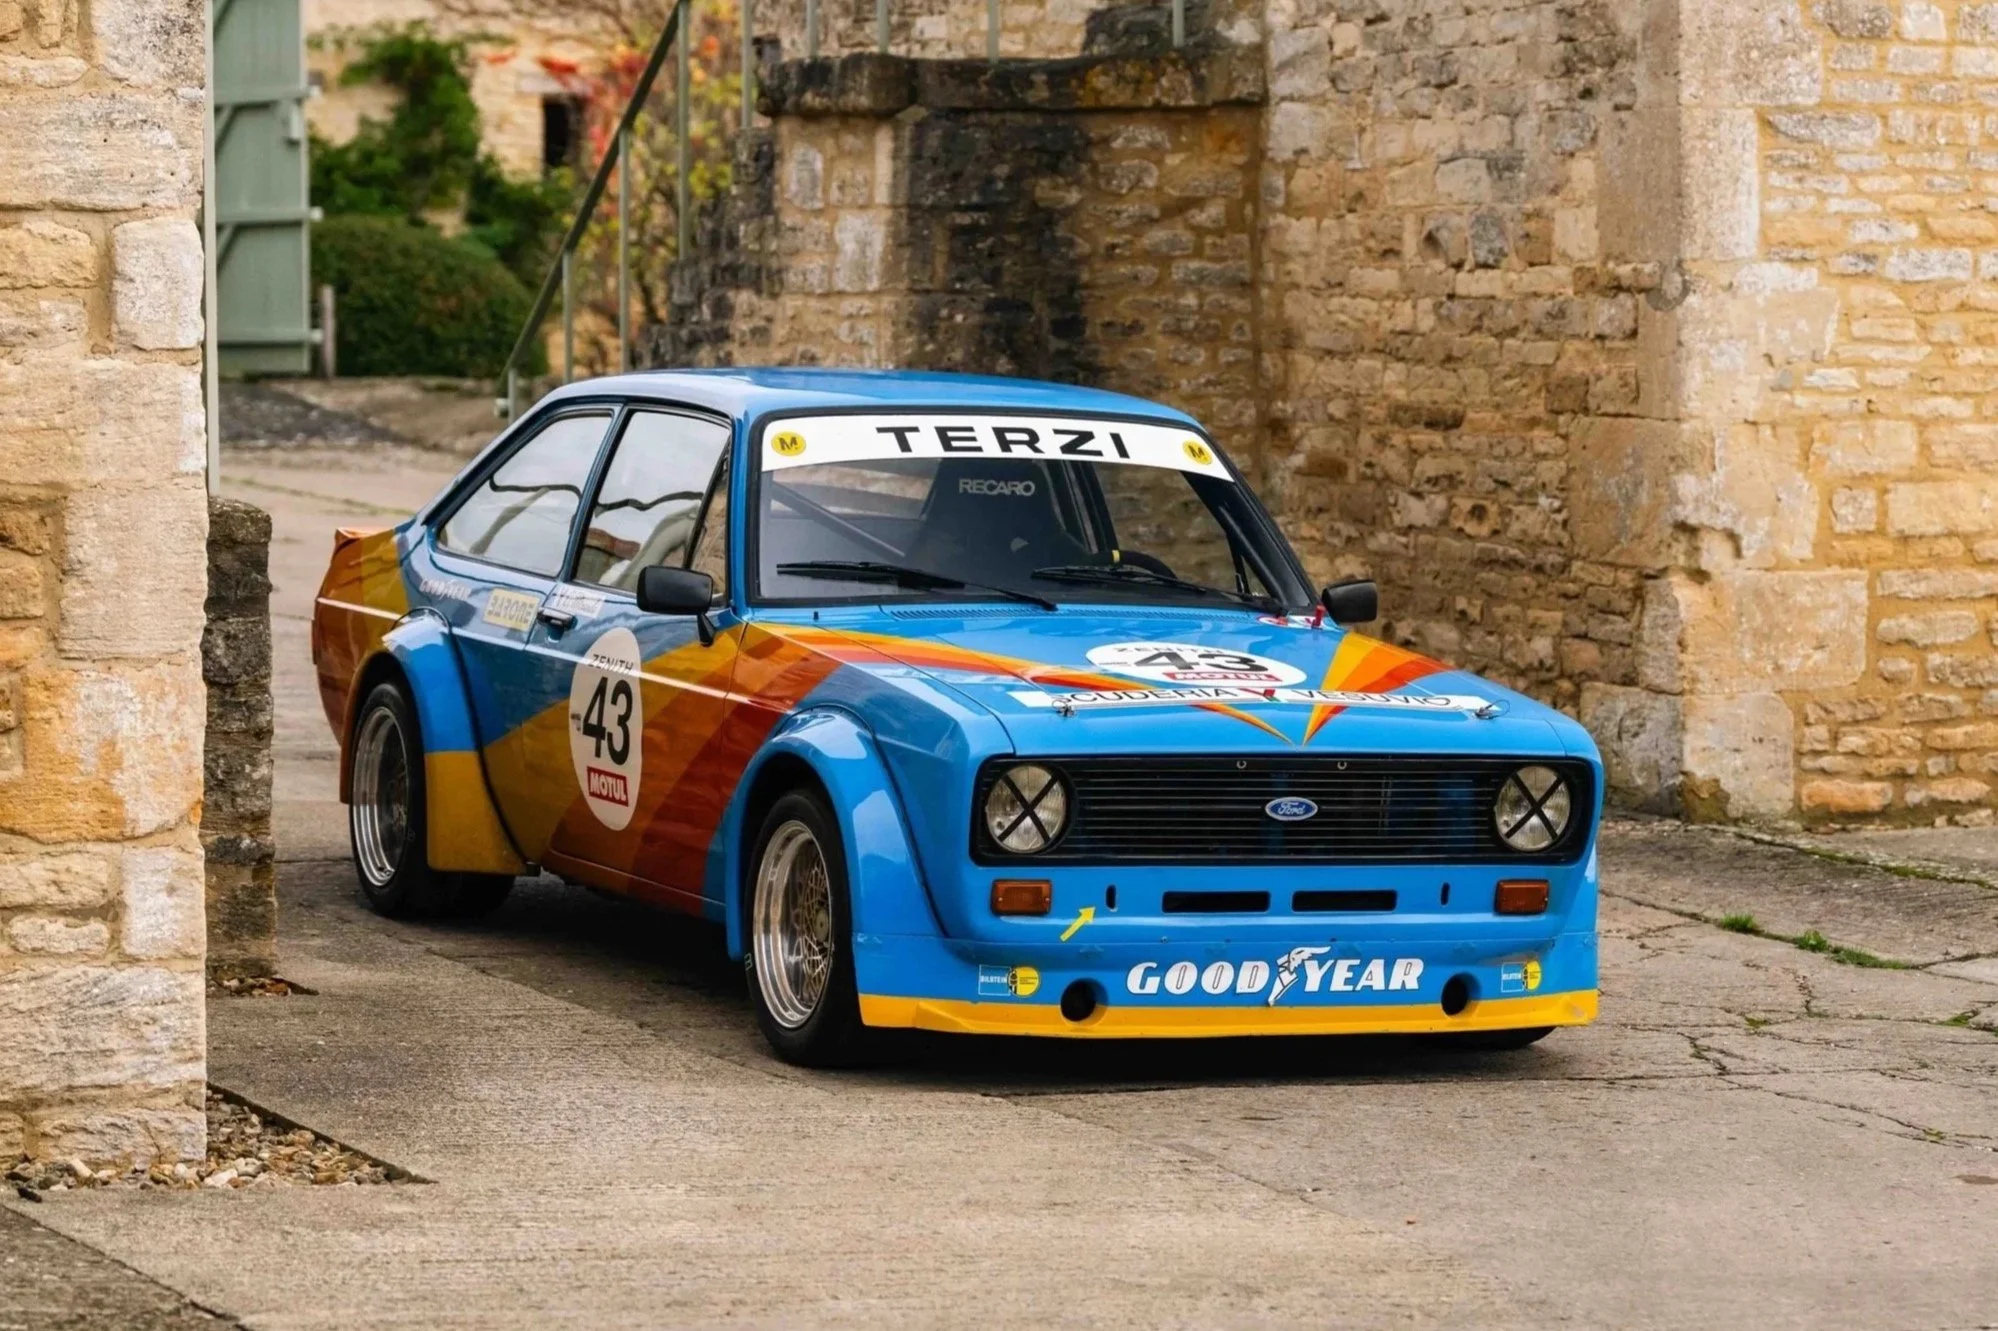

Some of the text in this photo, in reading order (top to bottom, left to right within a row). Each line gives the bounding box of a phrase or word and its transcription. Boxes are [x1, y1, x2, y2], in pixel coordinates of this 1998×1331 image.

[876, 426, 1130, 459] TERZI
[959, 478, 1036, 496] RECARO
[1134, 652, 1269, 672] 43
[1171, 672, 1275, 682] MOTUL
[1292, 689, 1451, 706] VESUVIO
[582, 676, 633, 766] 43
[590, 772, 627, 802] MOTUL
[1278, 802, 1306, 815] Ford
